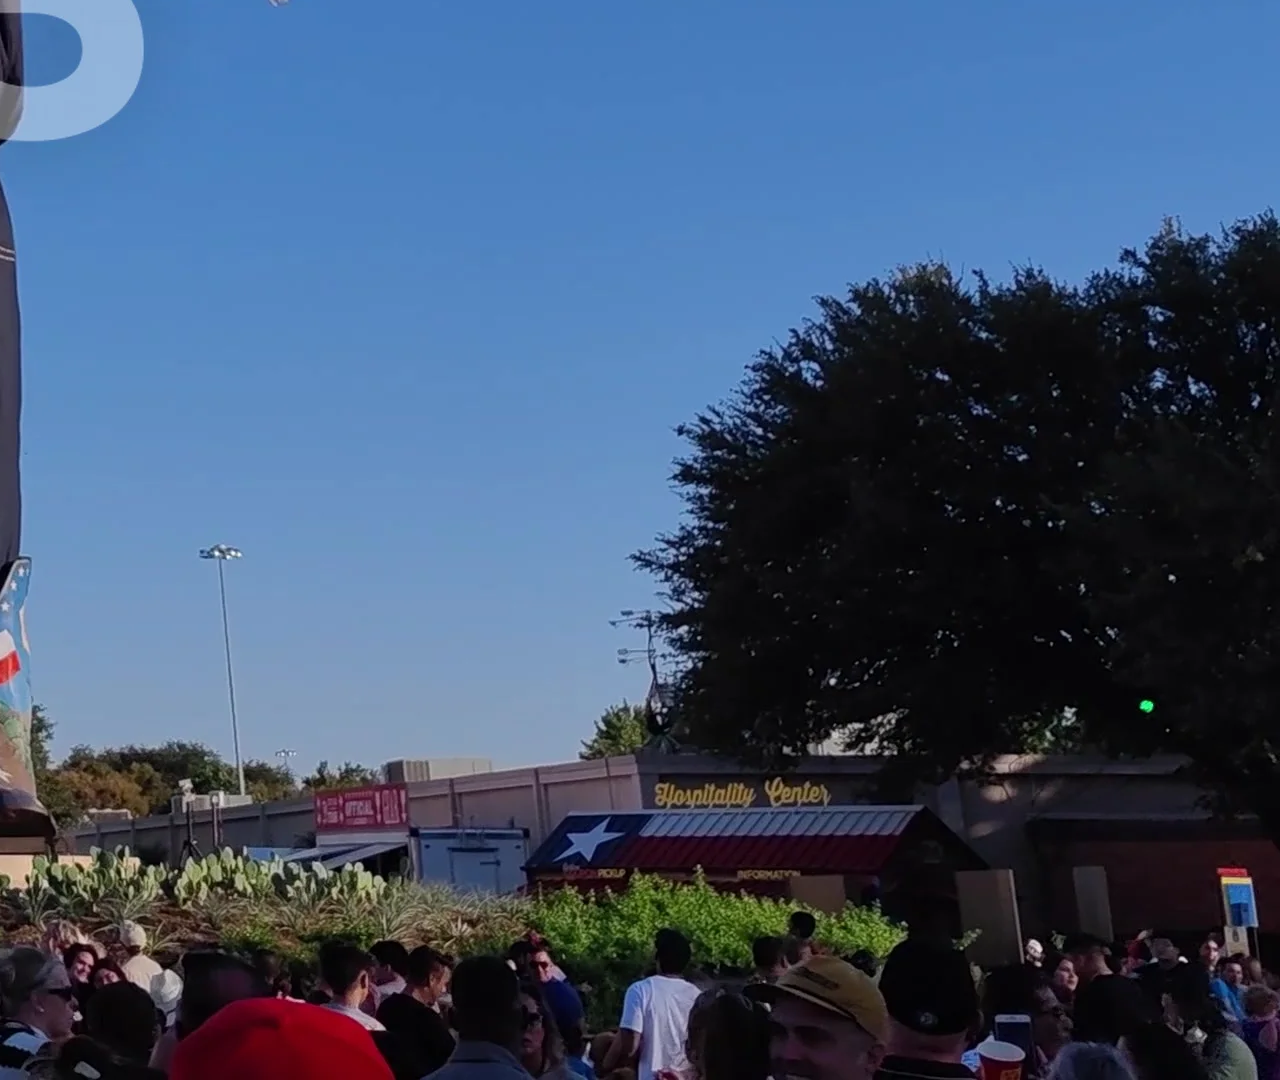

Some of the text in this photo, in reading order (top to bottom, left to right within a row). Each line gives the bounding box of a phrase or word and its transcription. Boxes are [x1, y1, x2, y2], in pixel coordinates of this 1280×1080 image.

[655, 777, 831, 809] Hospitality Center
[597, 869, 626, 878] PICKUP
[737, 870, 801, 880] INFORMATION
